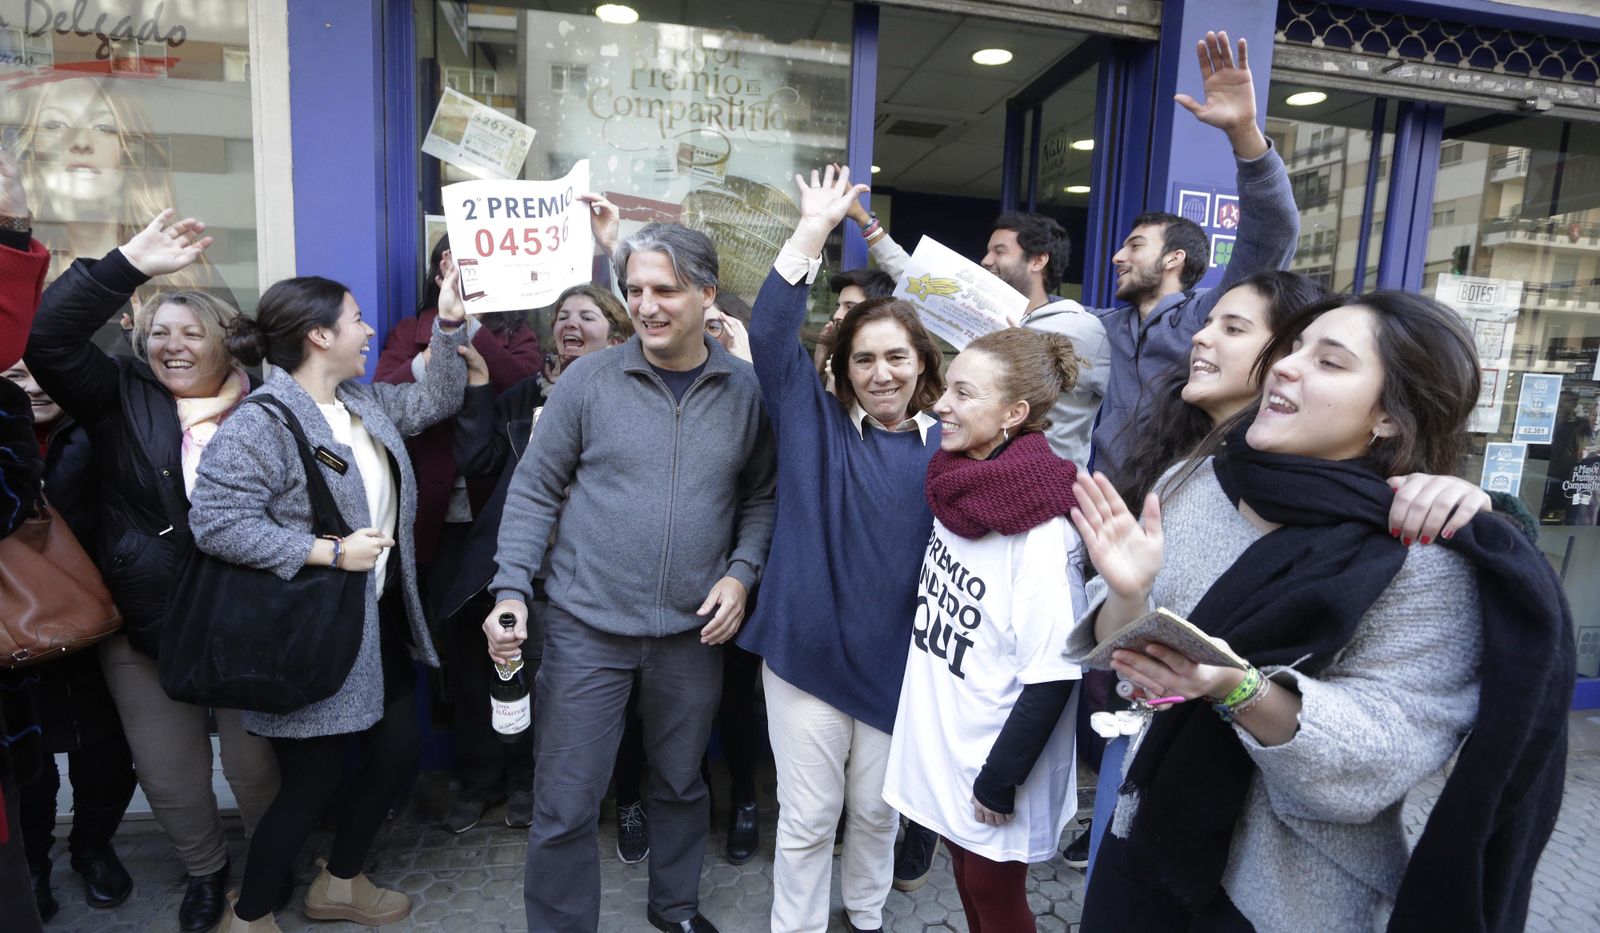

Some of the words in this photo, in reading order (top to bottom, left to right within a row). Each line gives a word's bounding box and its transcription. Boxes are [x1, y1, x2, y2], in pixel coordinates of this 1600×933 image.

[25, 0, 187, 60] Delgado
[629, 54, 743, 98] Premio
[487, 186, 573, 218] PREMIO
[475, 216, 569, 257] 04536
[1461, 284, 1493, 302] BOTES
